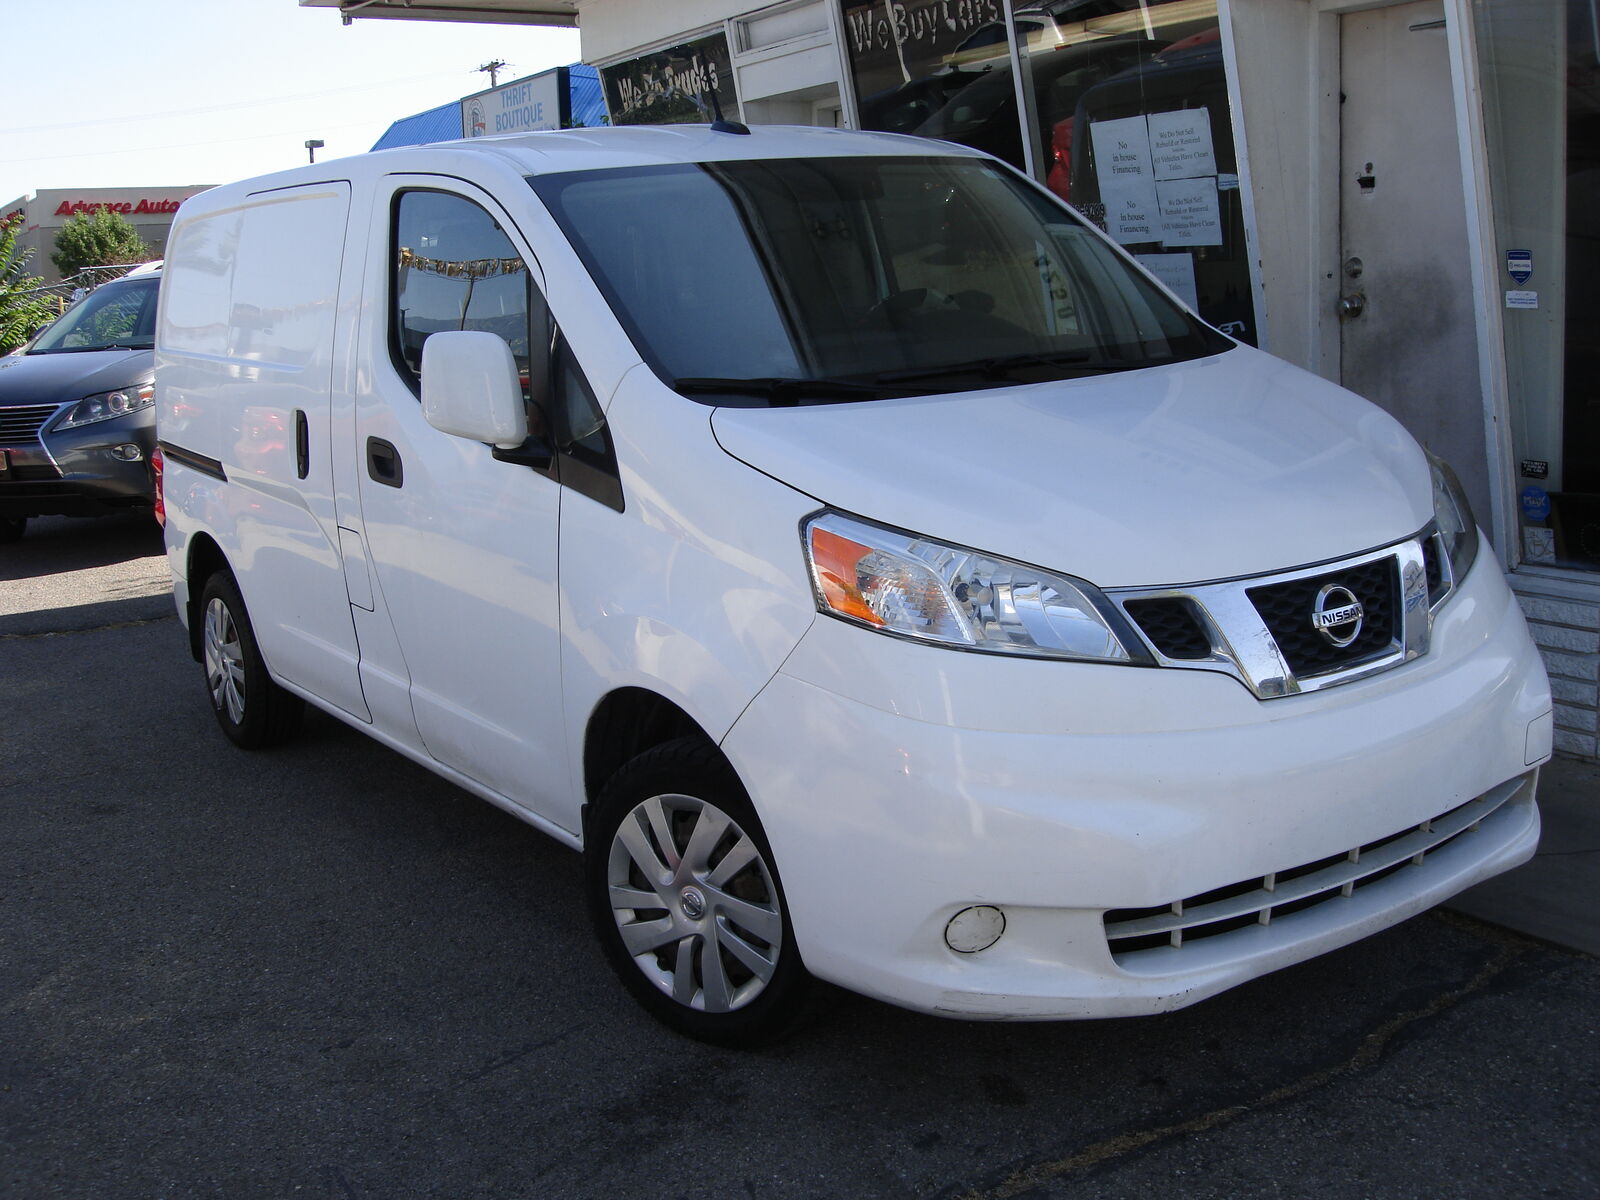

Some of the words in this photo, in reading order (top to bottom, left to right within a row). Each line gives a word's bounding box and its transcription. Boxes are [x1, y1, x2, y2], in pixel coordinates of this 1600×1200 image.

[850, 10, 888, 52] We
[893, 3, 937, 45] Buy
[943, 0, 998, 31] Cars
[500, 82, 532, 108] THRIFT
[495, 102, 544, 132] BOUTIQUE
[1118, 141, 1128, 149] No
[1119, 153, 1137, 161] house
[133, 198, 181, 214] Auto
[1126, 201, 1136, 209] No
[1127, 213, 1145, 221] house
[1322, 605, 1361, 624] NISSAN
